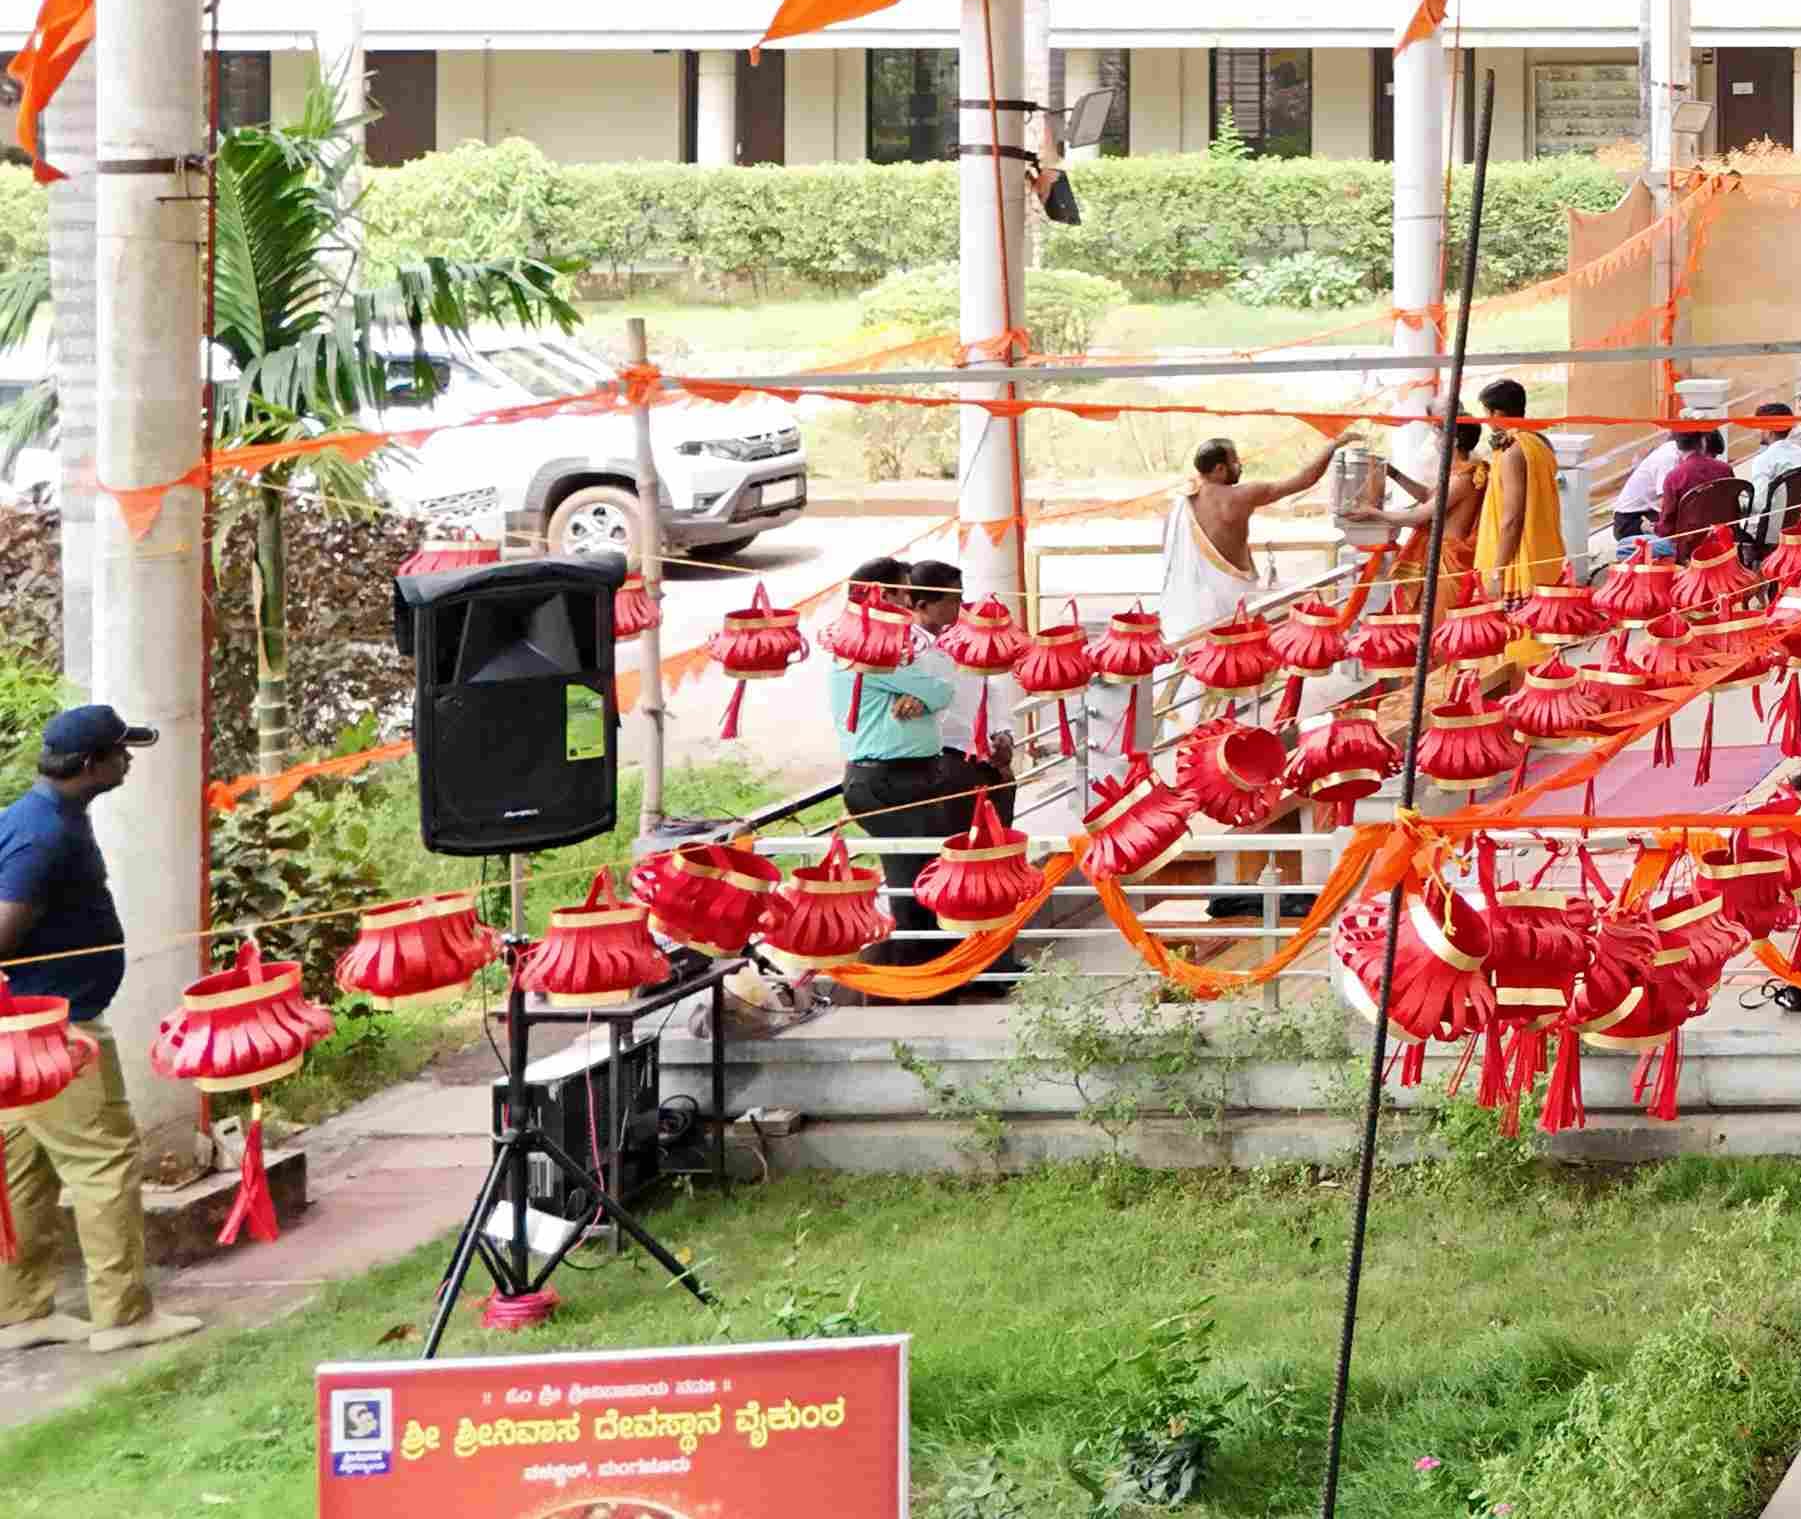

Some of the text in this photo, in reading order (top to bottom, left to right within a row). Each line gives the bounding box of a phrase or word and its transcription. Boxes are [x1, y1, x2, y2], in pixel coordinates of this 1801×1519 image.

[400, 1395, 847, 1460] ಶ್ರೀ ಶ್ರೀನಿವಾಸ ದೇವಸ್ಥಾನ ವೈಕುಂಠ
